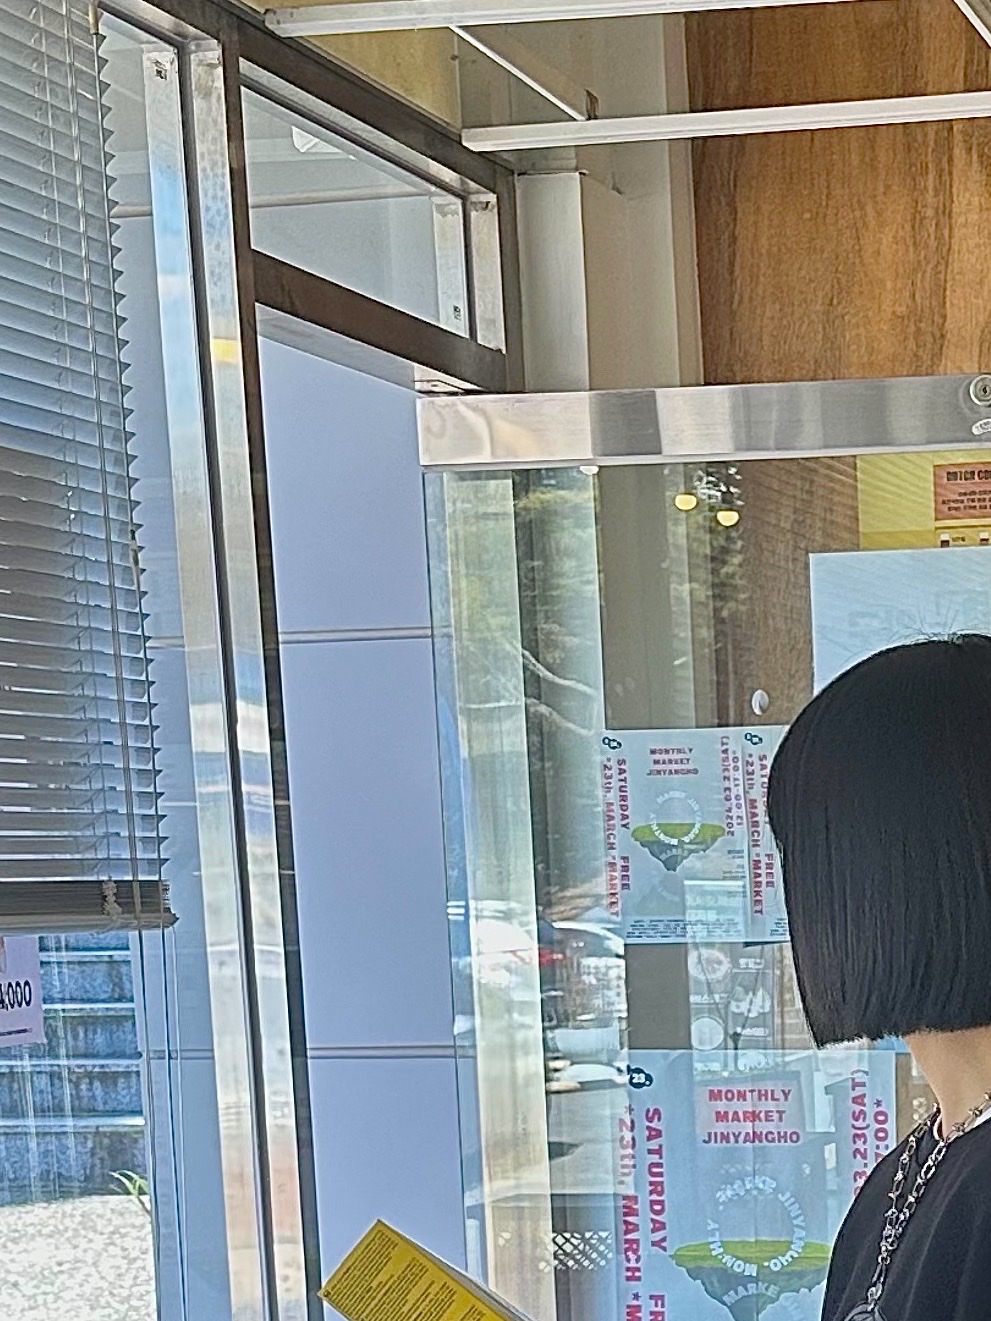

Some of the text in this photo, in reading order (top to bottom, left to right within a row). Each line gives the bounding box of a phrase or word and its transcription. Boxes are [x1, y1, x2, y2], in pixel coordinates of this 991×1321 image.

[617, 758, 631, 830] SATURDAY
[604, 802, 616, 852] MARCH
[748, 798, 761, 849] MARCH
[708, 1089, 792, 1103] MONTHLY
[715, 1110, 786, 1123] MARKET
[702, 1131, 801, 1144] JINYANGHO
[645, 1107, 667, 1253] SATURDAY
[622, 1194, 642, 1282] MARCH
